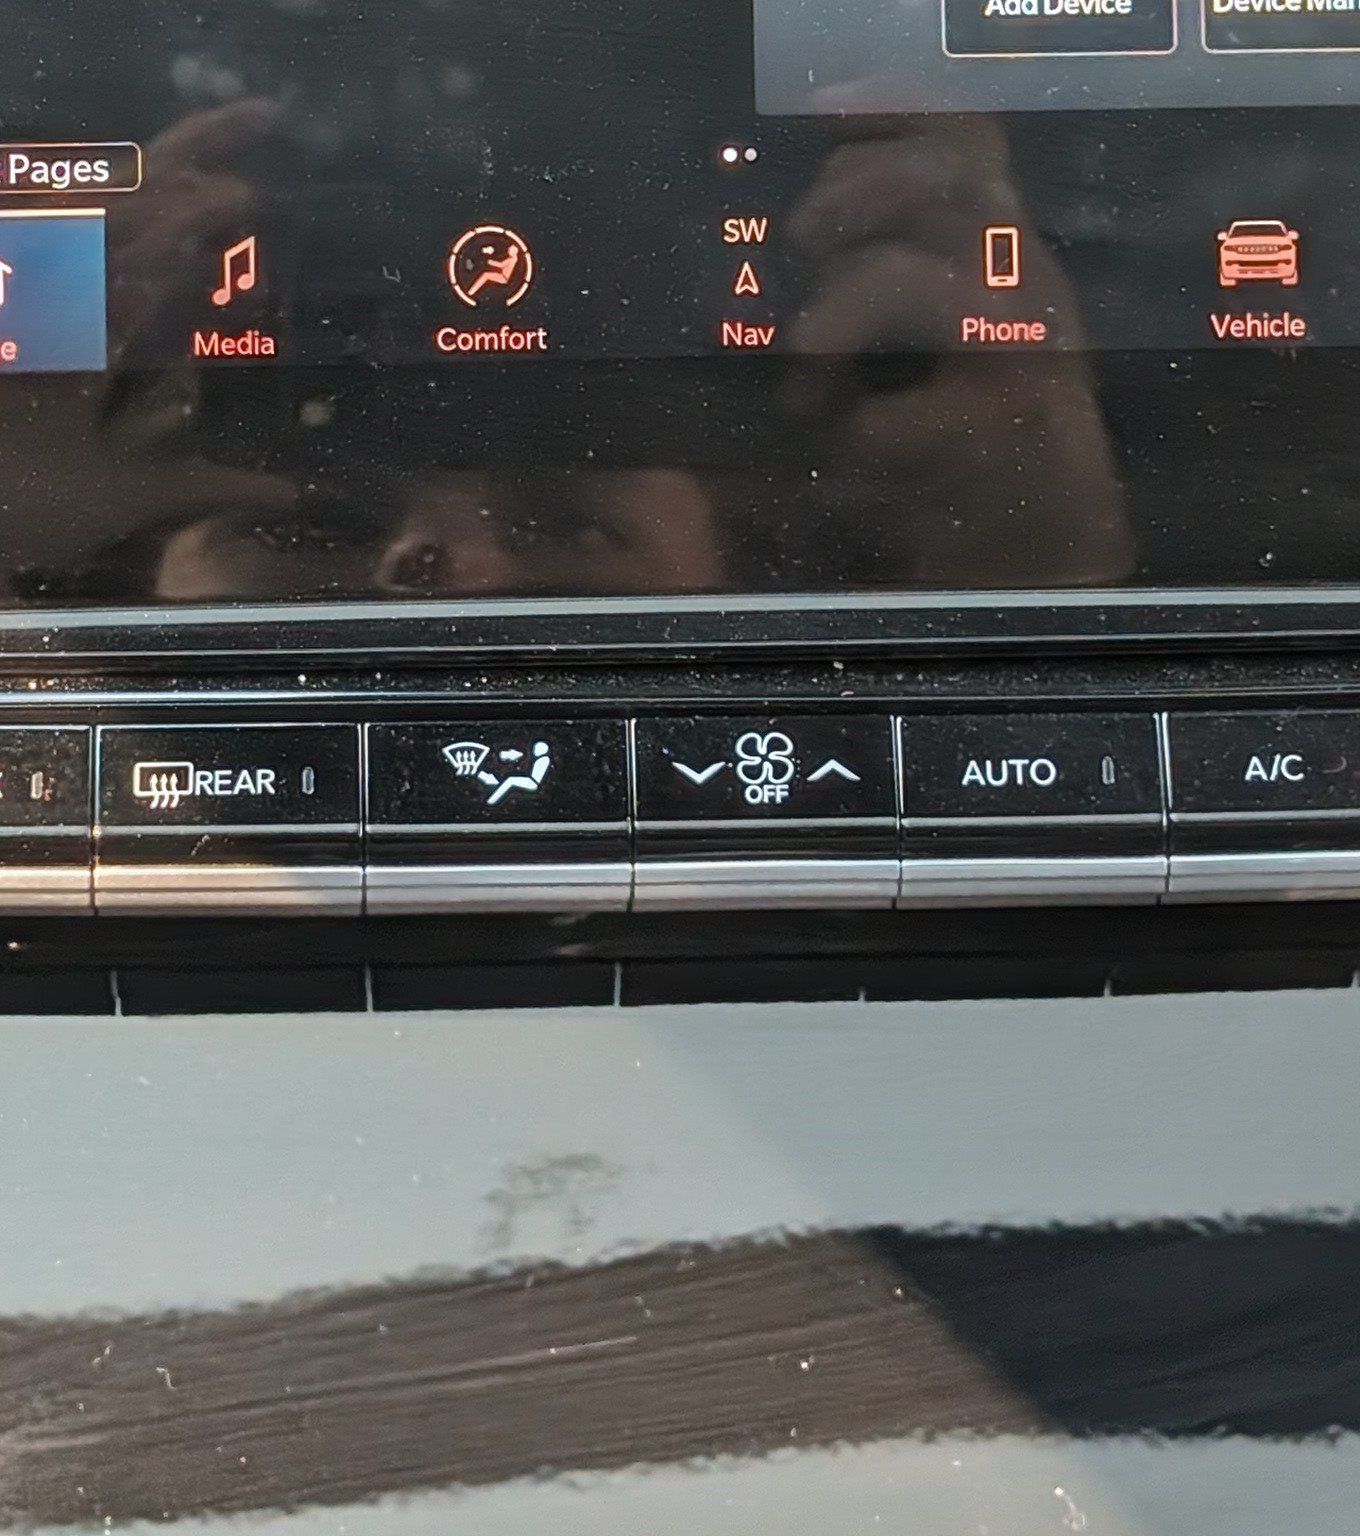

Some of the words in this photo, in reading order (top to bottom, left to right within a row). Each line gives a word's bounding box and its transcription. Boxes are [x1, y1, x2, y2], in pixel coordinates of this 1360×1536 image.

[8, 154, 110, 190] Pages
[722, 216, 767, 245] SW
[437, 325, 548, 353] Comfort
[722, 320, 775, 347] Nav
[960, 316, 1047, 343] Phone
[1210, 310, 1306, 340] Vehicle
[192, 330, 277, 358] Media
[193, 768, 276, 797] REAR
[961, 757, 1057, 788] AUTO
[1244, 753, 1304, 784] A/C
[745, 784, 791, 805] OFF
